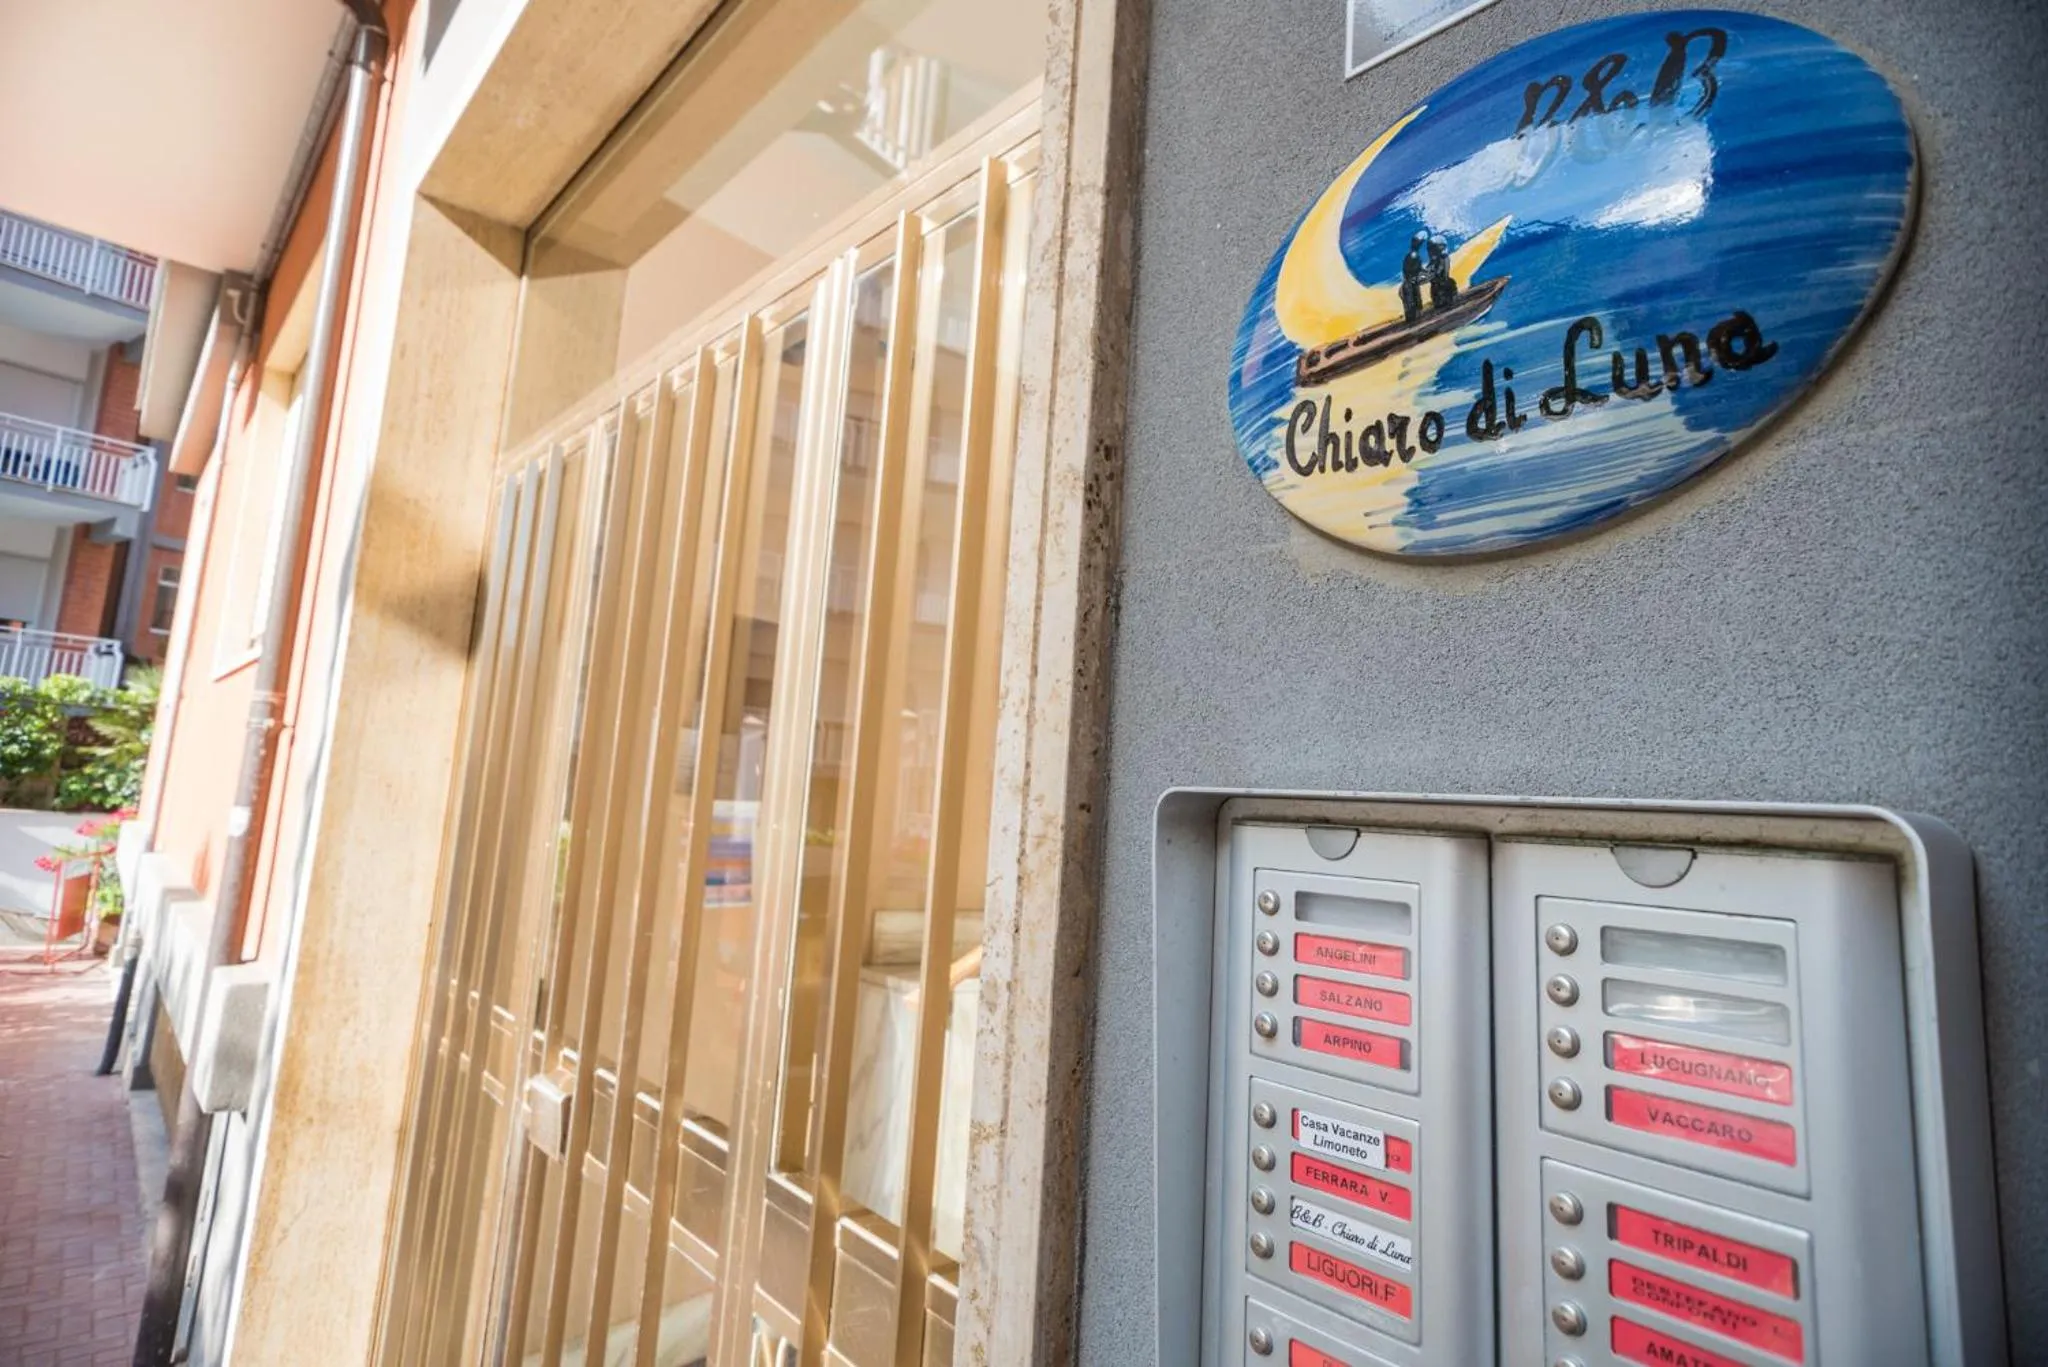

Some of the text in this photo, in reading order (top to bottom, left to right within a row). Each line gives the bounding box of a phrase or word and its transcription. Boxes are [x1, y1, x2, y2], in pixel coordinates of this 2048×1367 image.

[1285, 310, 1779, 477] Chiaro di Luna
[1315, 945, 1376, 966] ANGELINI
[1319, 989, 1383, 1012] SALZANO
[1323, 1033, 1372, 1054] ARPINO
[1639, 1051, 1770, 1088] LUCUGNANO
[1300, 1114, 1380, 1147] Casa Vacanze
[1647, 1106, 1753, 1143] VACCARO
[1313, 1134, 1368, 1160] Limoneto
[1305, 1165, 1369, 1197] FERRARA
[1291, 1205, 1325, 1229] B&B
[1331, 1221, 1365, 1246] Chiaro
[1367, 1234, 1379, 1251] di
[1379, 1240, 1413, 1265] Luna
[1652, 1228, 1748, 1273] TRIPALDI
